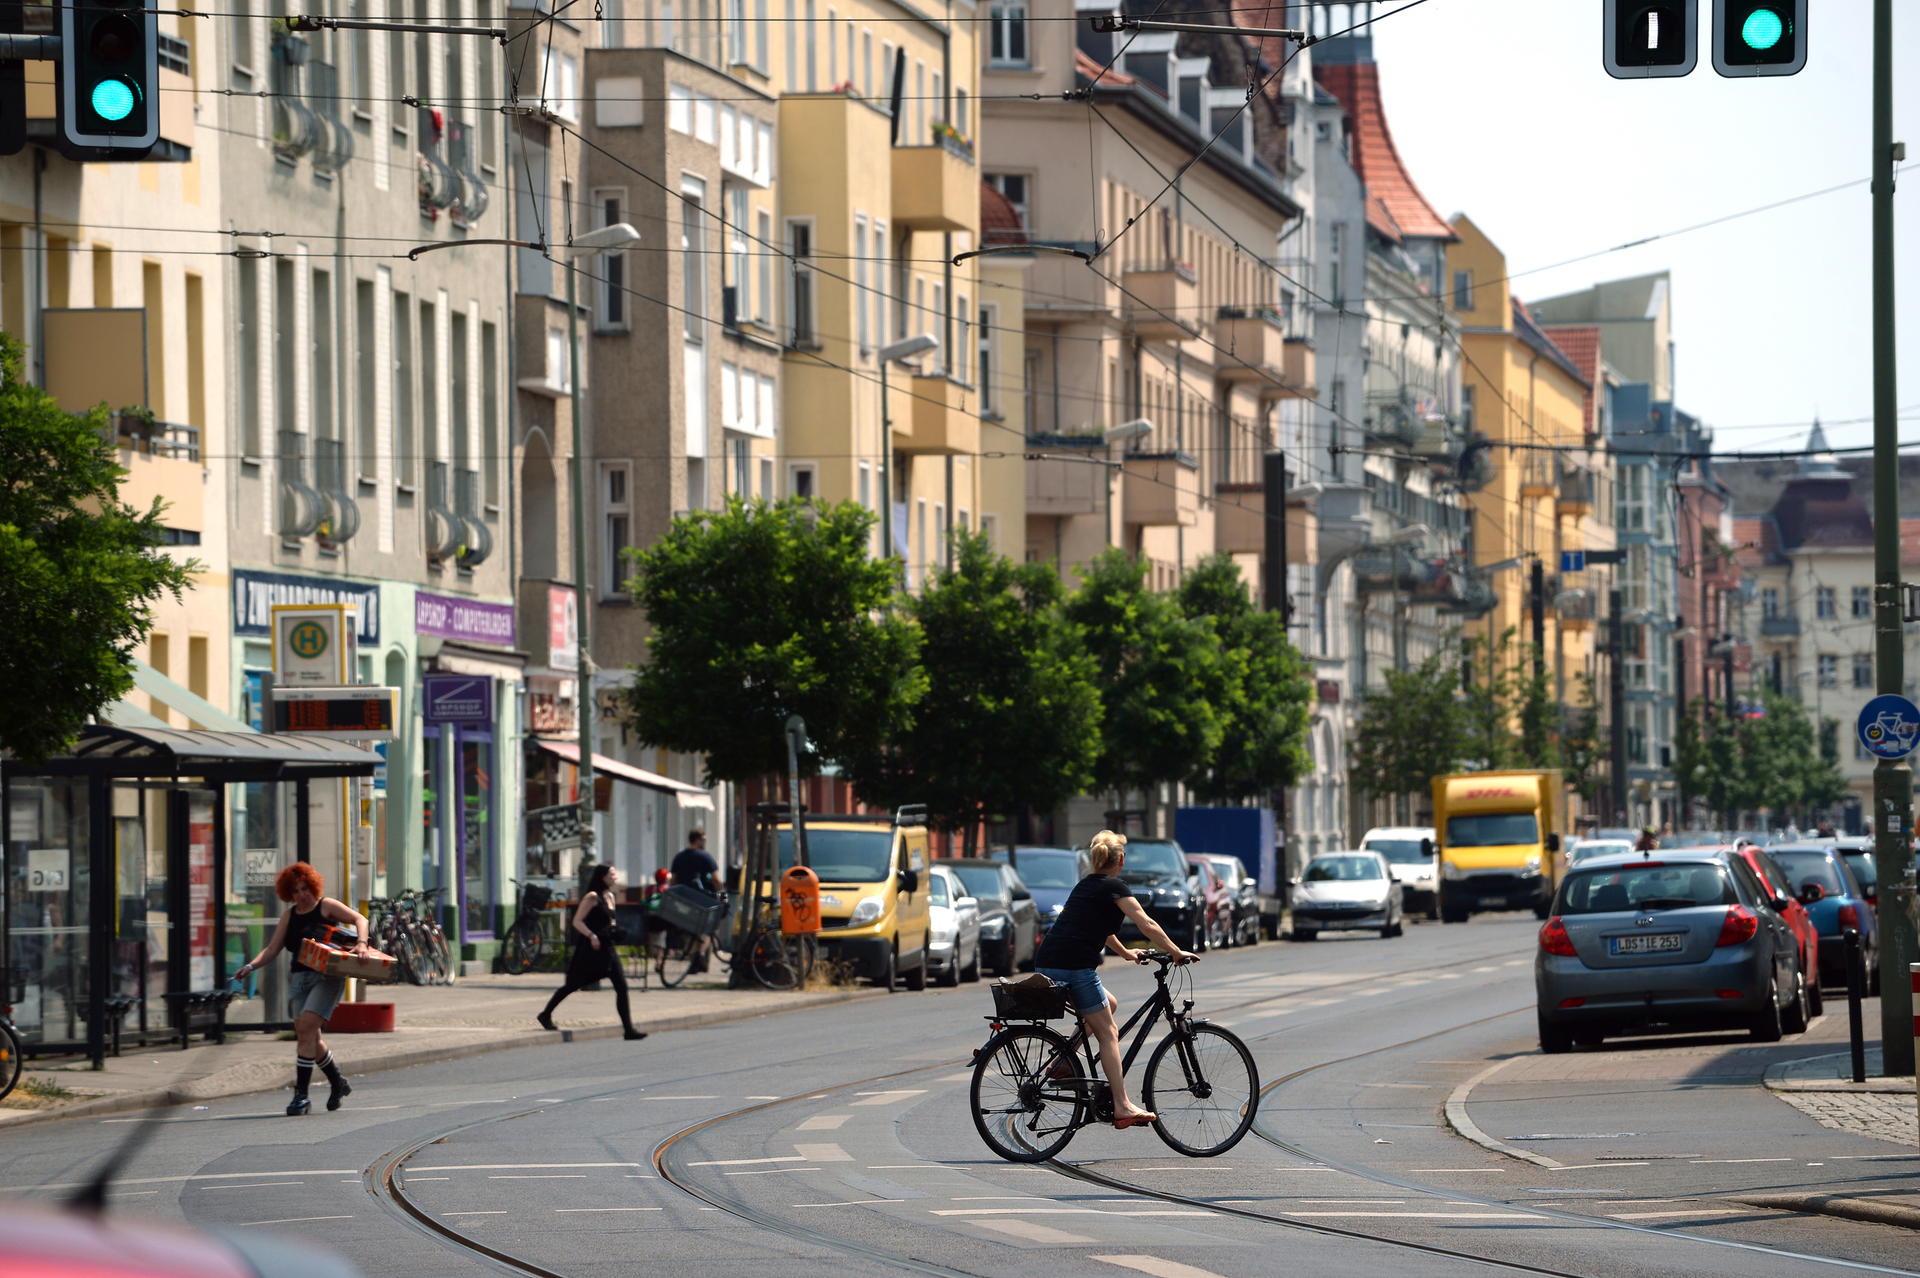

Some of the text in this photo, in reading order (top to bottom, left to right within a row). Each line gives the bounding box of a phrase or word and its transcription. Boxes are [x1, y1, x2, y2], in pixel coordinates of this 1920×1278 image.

[417, 600, 446, 629] LAPSHOP
[1618, 934, 1679, 951] LDS IE 253
